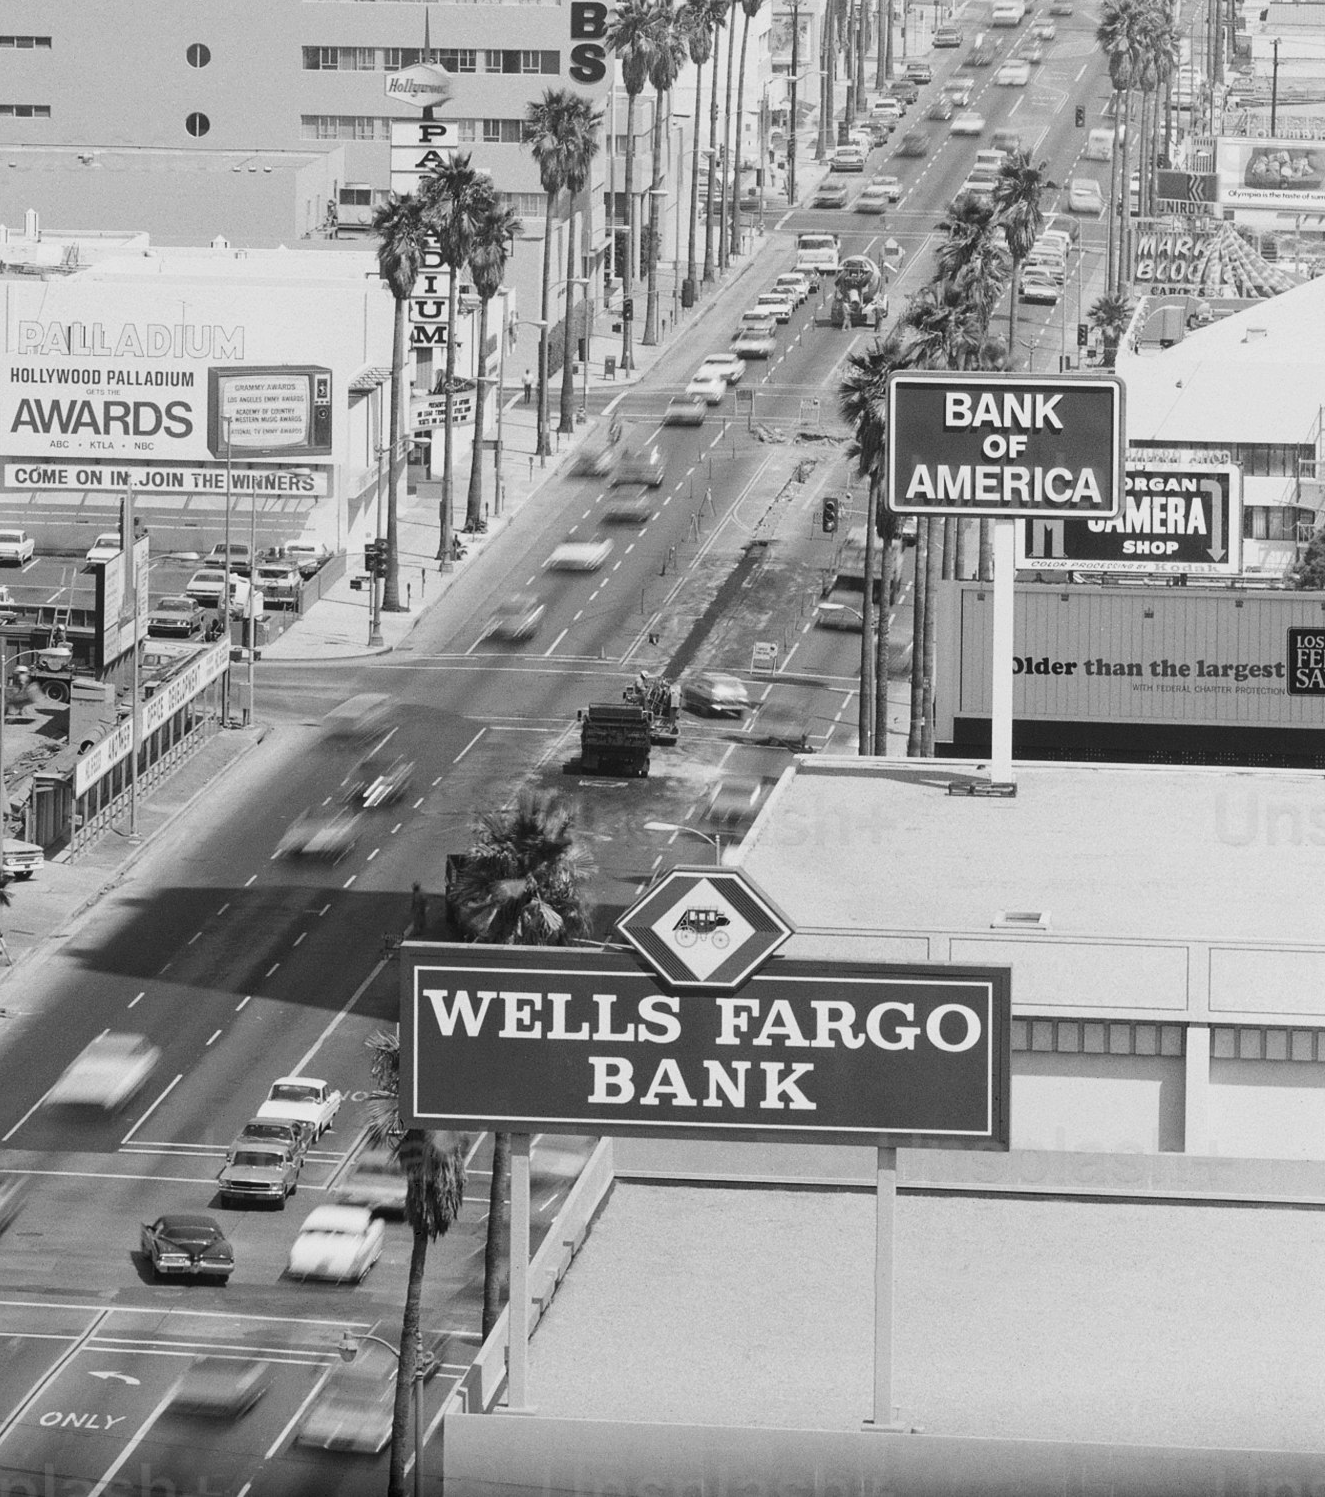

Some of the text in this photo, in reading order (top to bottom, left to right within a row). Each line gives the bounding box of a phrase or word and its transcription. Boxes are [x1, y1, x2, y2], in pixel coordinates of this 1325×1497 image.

[1228, 189, 1262, 199] Olympia
[1262, 190, 1268, 198] is
[1269, 189, 1281, 198] the
[1282, 190, 1300, 199] taste
[414, 124, 447, 344] PAADIUM
[1150, 285, 1225, 298] CAROSEL
[18, 320, 245, 360] PALLADIUM
[10, 367, 194, 387] HOLLYWOOD PALLADIUM
[85, 388, 121, 396] GETS THE
[266, 383, 296, 391] AWARDS
[10, 398, 193, 439] AWARDS
[279, 415, 302, 423] AWARDS
[945, 391, 1064, 430] BANK
[230, 428, 252, 436] ATIONAL
[49, 439, 154, 451] ABC KTLA NBC
[982, 434, 1028, 459] OF
[14, 467, 68, 485] COME
[75, 469, 103, 486] ON
[191, 473, 224, 489] THE
[231, 475, 315, 492] WINNERS
[905, 464, 1102, 505] AMERICA
[1126, 477, 1197, 493] ORGAN
[1122, 539, 1179, 555] SHOP
[1031, 560, 1068, 569] COLOR
[1070, 561, 1133, 571] PROCESSING
[1152, 562, 1221, 574] Kodak
[1296, 635, 1325, 649] LOS
[1296, 649, 1325, 668] FE
[1012, 656, 1286, 683] Older than the largest
[1132, 683, 1286, 696] WITH FEDERAL CHARTER PROTECTION
[422, 989, 982, 1053] WELLS FARGO
[587, 1056, 817, 1111] BANK
[39, 1410, 127, 1431] ONLY
